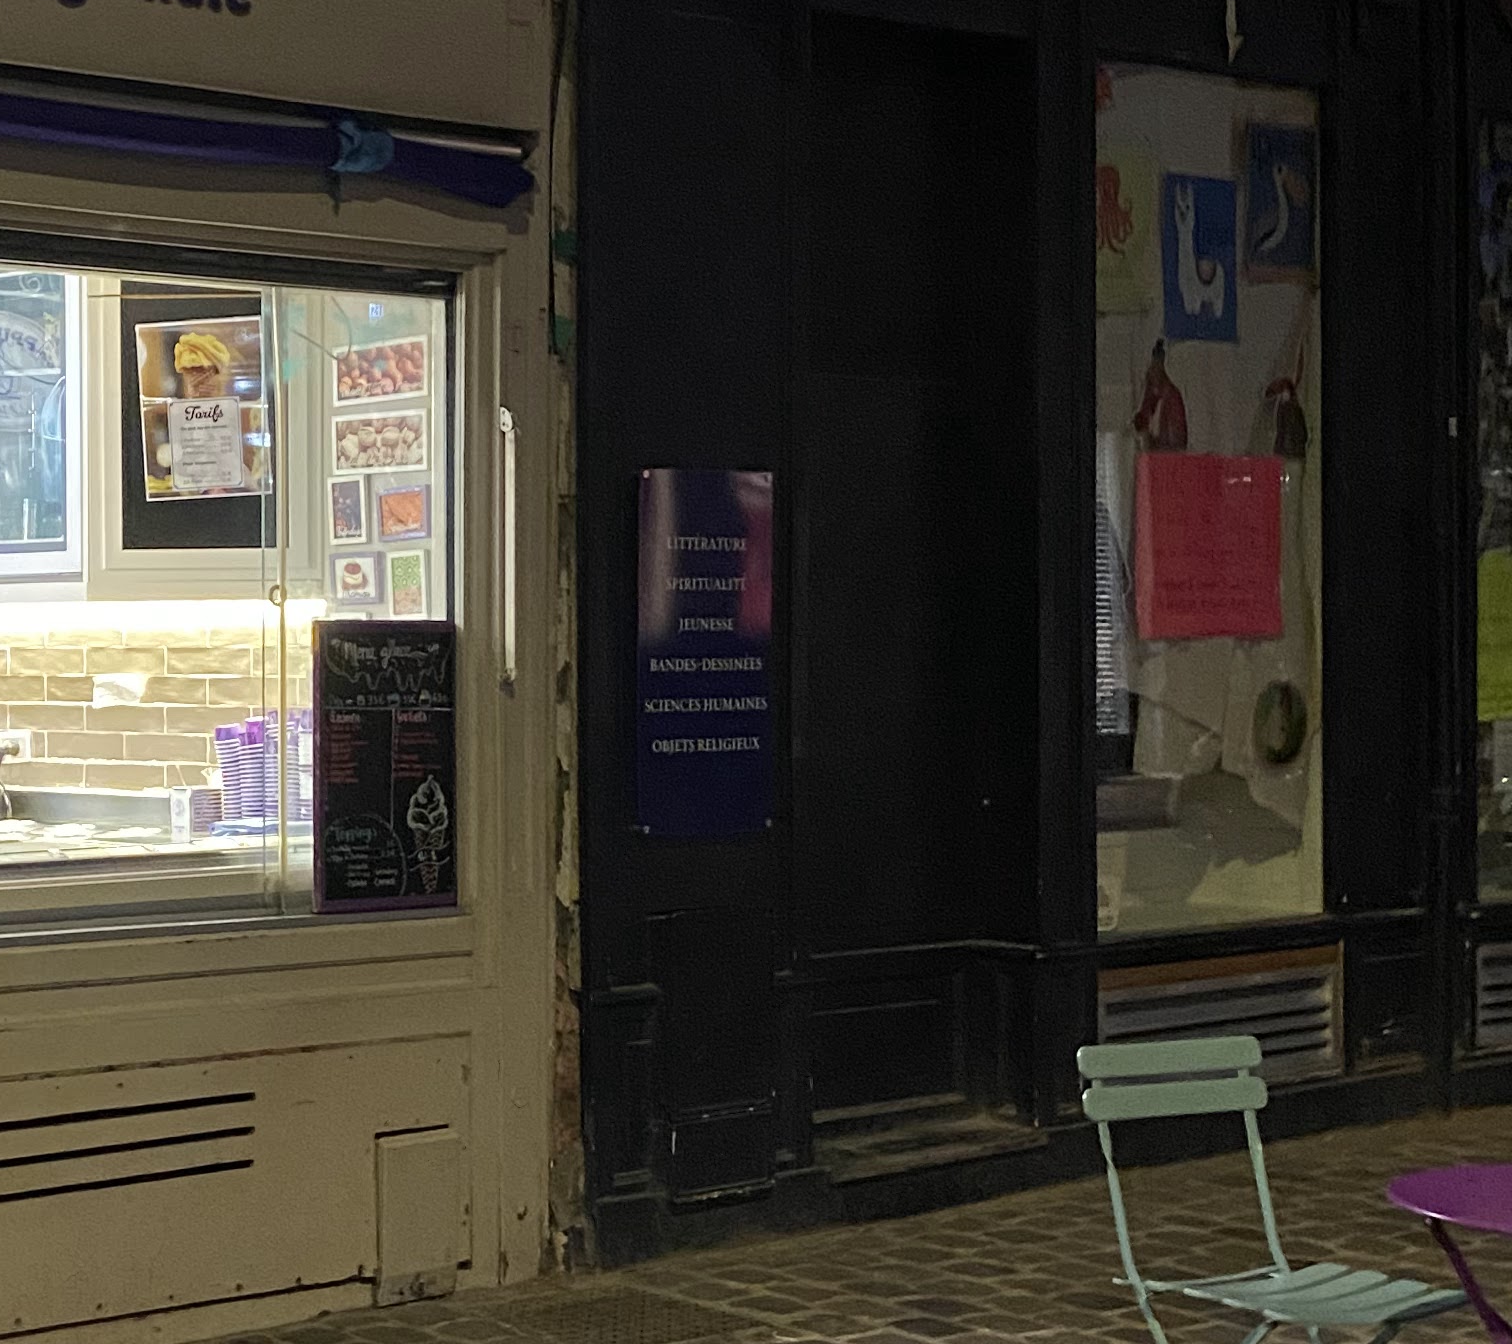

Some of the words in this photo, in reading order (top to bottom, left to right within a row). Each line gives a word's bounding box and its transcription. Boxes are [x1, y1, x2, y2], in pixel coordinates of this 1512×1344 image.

[185, 404, 224, 423] Tarifs
[679, 617, 735, 632] JEUNESSE
[644, 697, 702, 713] SCIENCES
[703, 696, 768, 712] HUMAINES
[652, 739, 696, 756] OBJETS
[697, 736, 760, 753] RELIGIEUX
